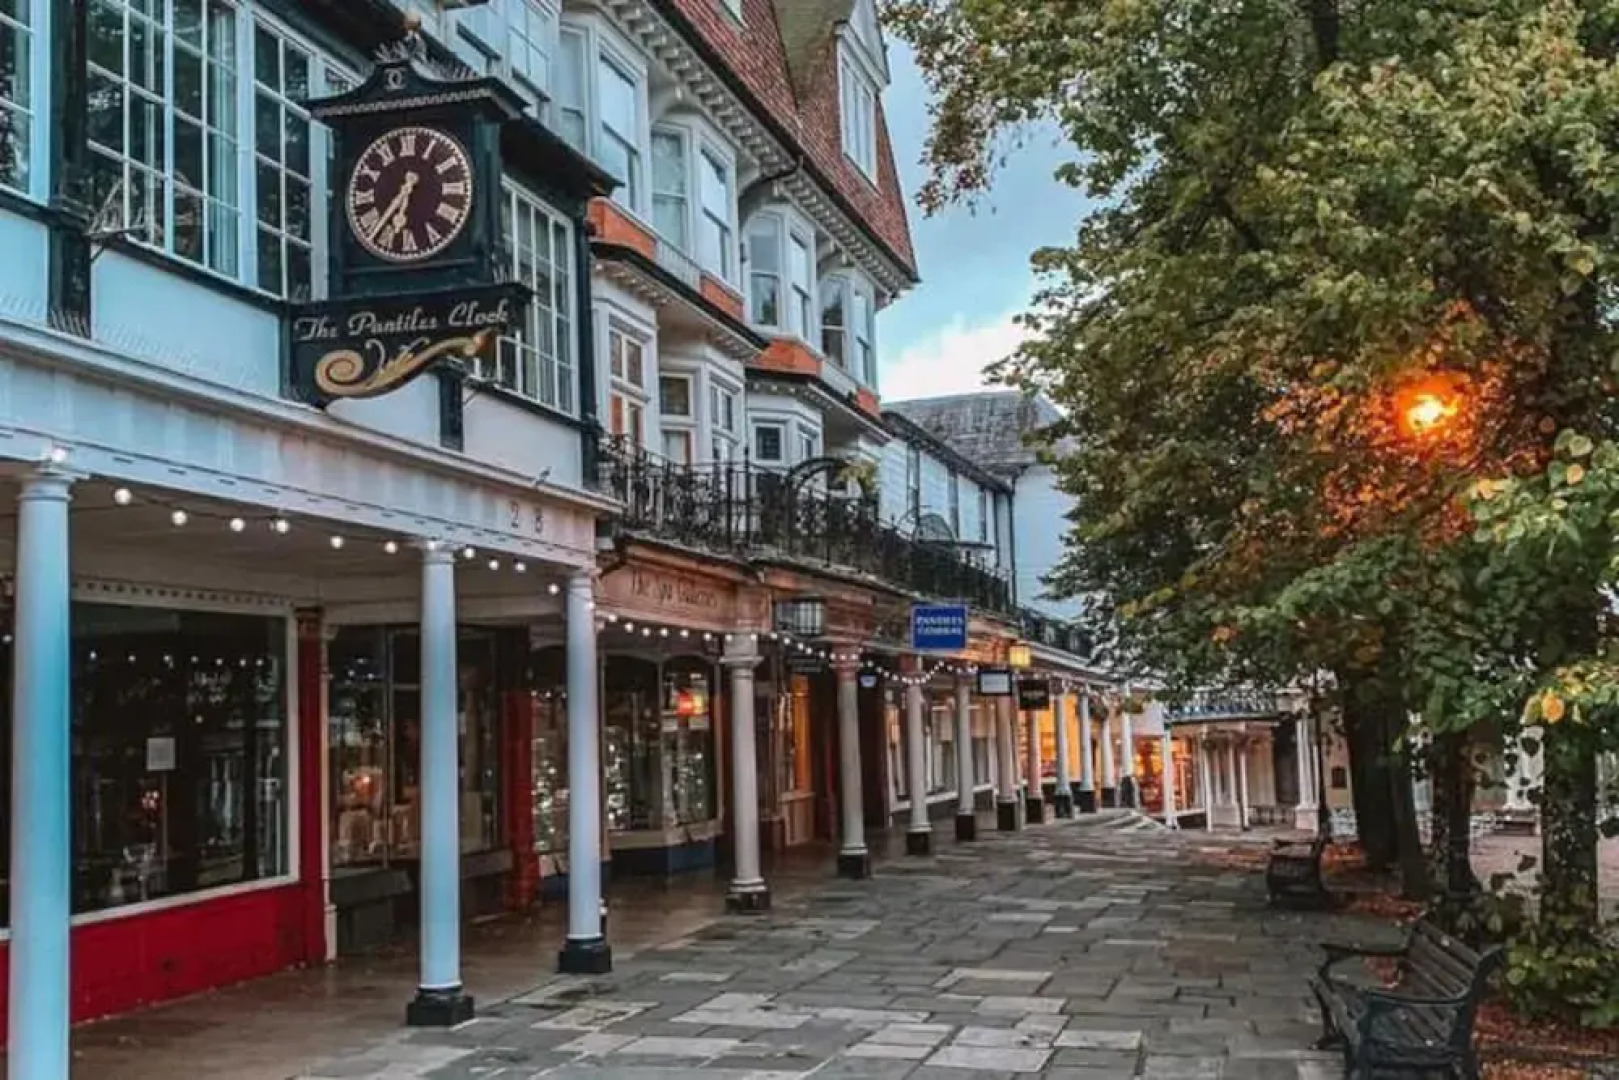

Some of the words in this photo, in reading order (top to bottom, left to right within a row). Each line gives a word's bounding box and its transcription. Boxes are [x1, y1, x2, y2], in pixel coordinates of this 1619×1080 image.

[294, 317, 338, 341] The
[349, 306, 437, 337] Pantiles
[448, 299, 509, 326] Clock
